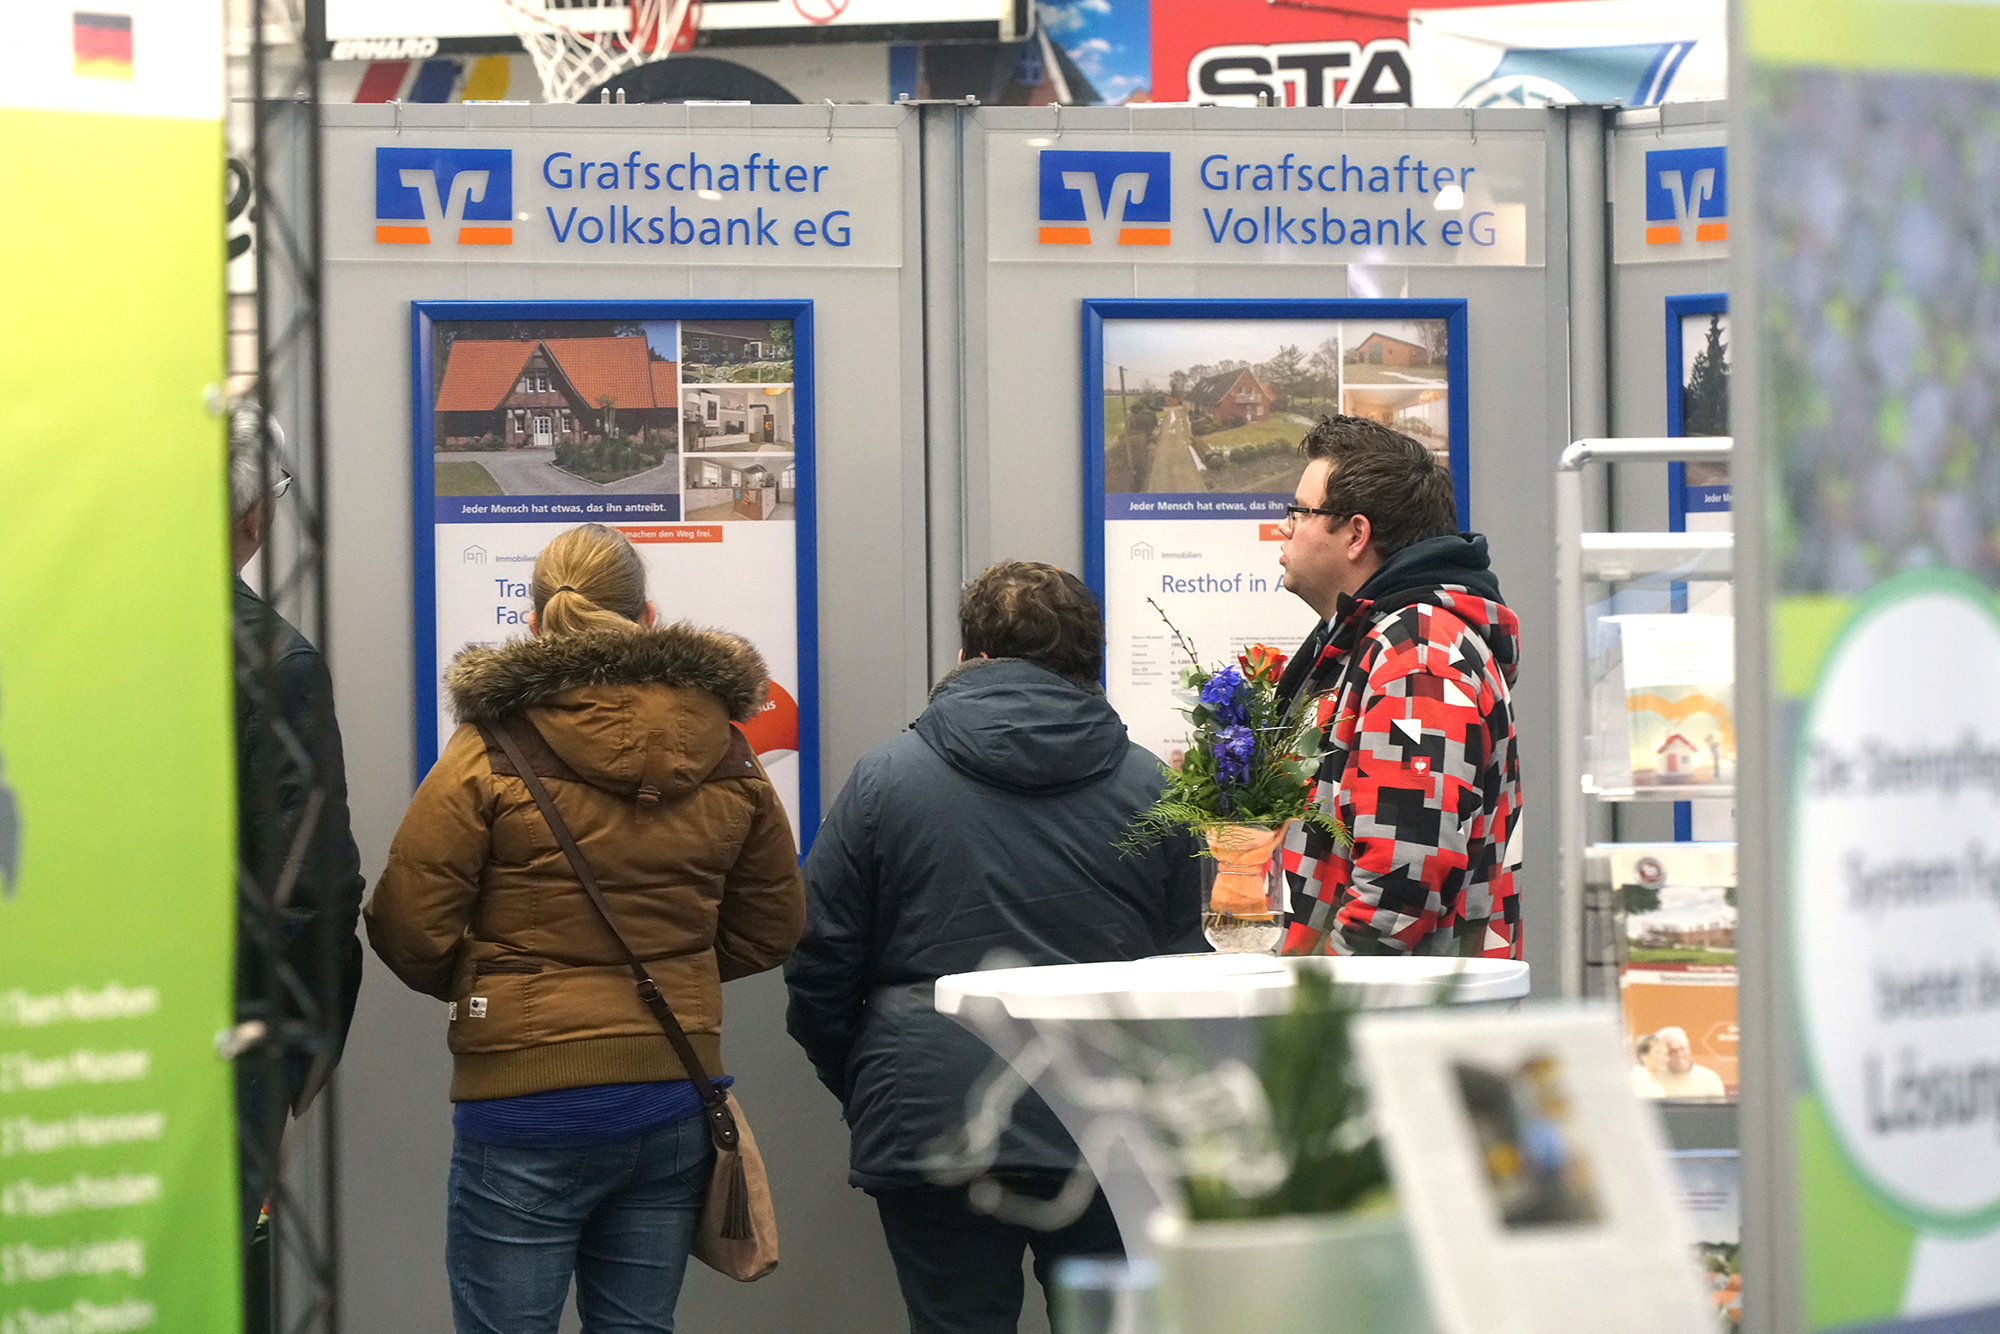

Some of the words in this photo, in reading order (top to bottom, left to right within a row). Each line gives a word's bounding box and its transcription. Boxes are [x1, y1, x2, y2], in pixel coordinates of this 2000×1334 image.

[542, 151, 829, 192] Grafschafter
[1200, 153, 1475, 193] Grafschafter
[546, 204, 779, 246] Volksbank
[793, 210, 852, 247] eG
[1203, 205, 1428, 246] Volksbank
[1440, 211, 1497, 247] eG
[461, 504, 488, 514] Jeder
[490, 503, 529, 513] Mensch
[531, 503, 549, 513] hat
[551, 504, 584, 514] etwas,
[586, 503, 604, 513] das
[606, 503, 622, 512] ihn
[624, 502, 667, 513] antreibt.
[1129, 501, 1154, 511] Jeder
[1157, 501, 1194, 511] Mensch
[1196, 501, 1213, 511] hat
[1215, 502, 1247, 511] etwas,
[1249, 501, 1266, 510] das
[1268, 500, 1284, 510] ihn
[658, 529, 675, 538] den
[676, 529, 694, 540] Weg
[695, 529, 713, 538] frei.
[1162, 551, 1202, 560] Immobilien
[1162, 573, 1242, 593] Resthof
[1249, 573, 1266, 592] in
